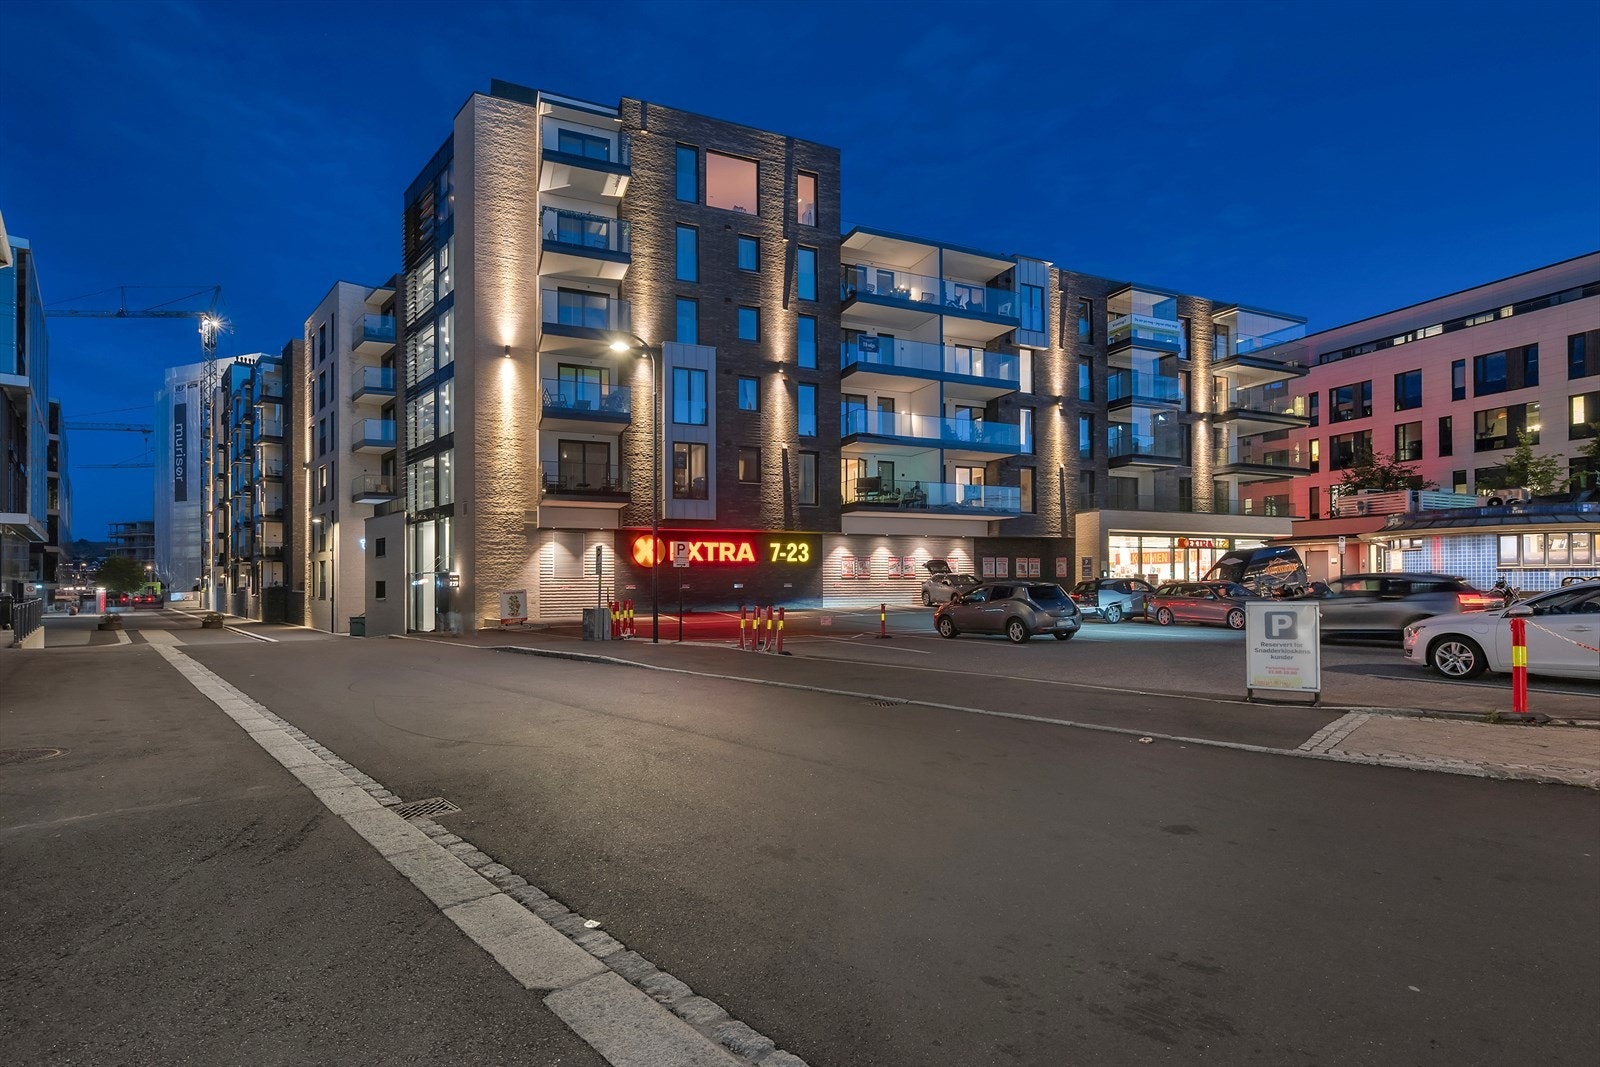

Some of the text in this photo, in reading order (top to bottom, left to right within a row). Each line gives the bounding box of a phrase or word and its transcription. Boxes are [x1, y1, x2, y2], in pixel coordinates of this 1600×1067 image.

[669, 542, 755, 562] XTRA
[677, 545, 686, 556] P
[769, 542, 809, 562] 7-23
[1272, 614, 1293, 637] P
